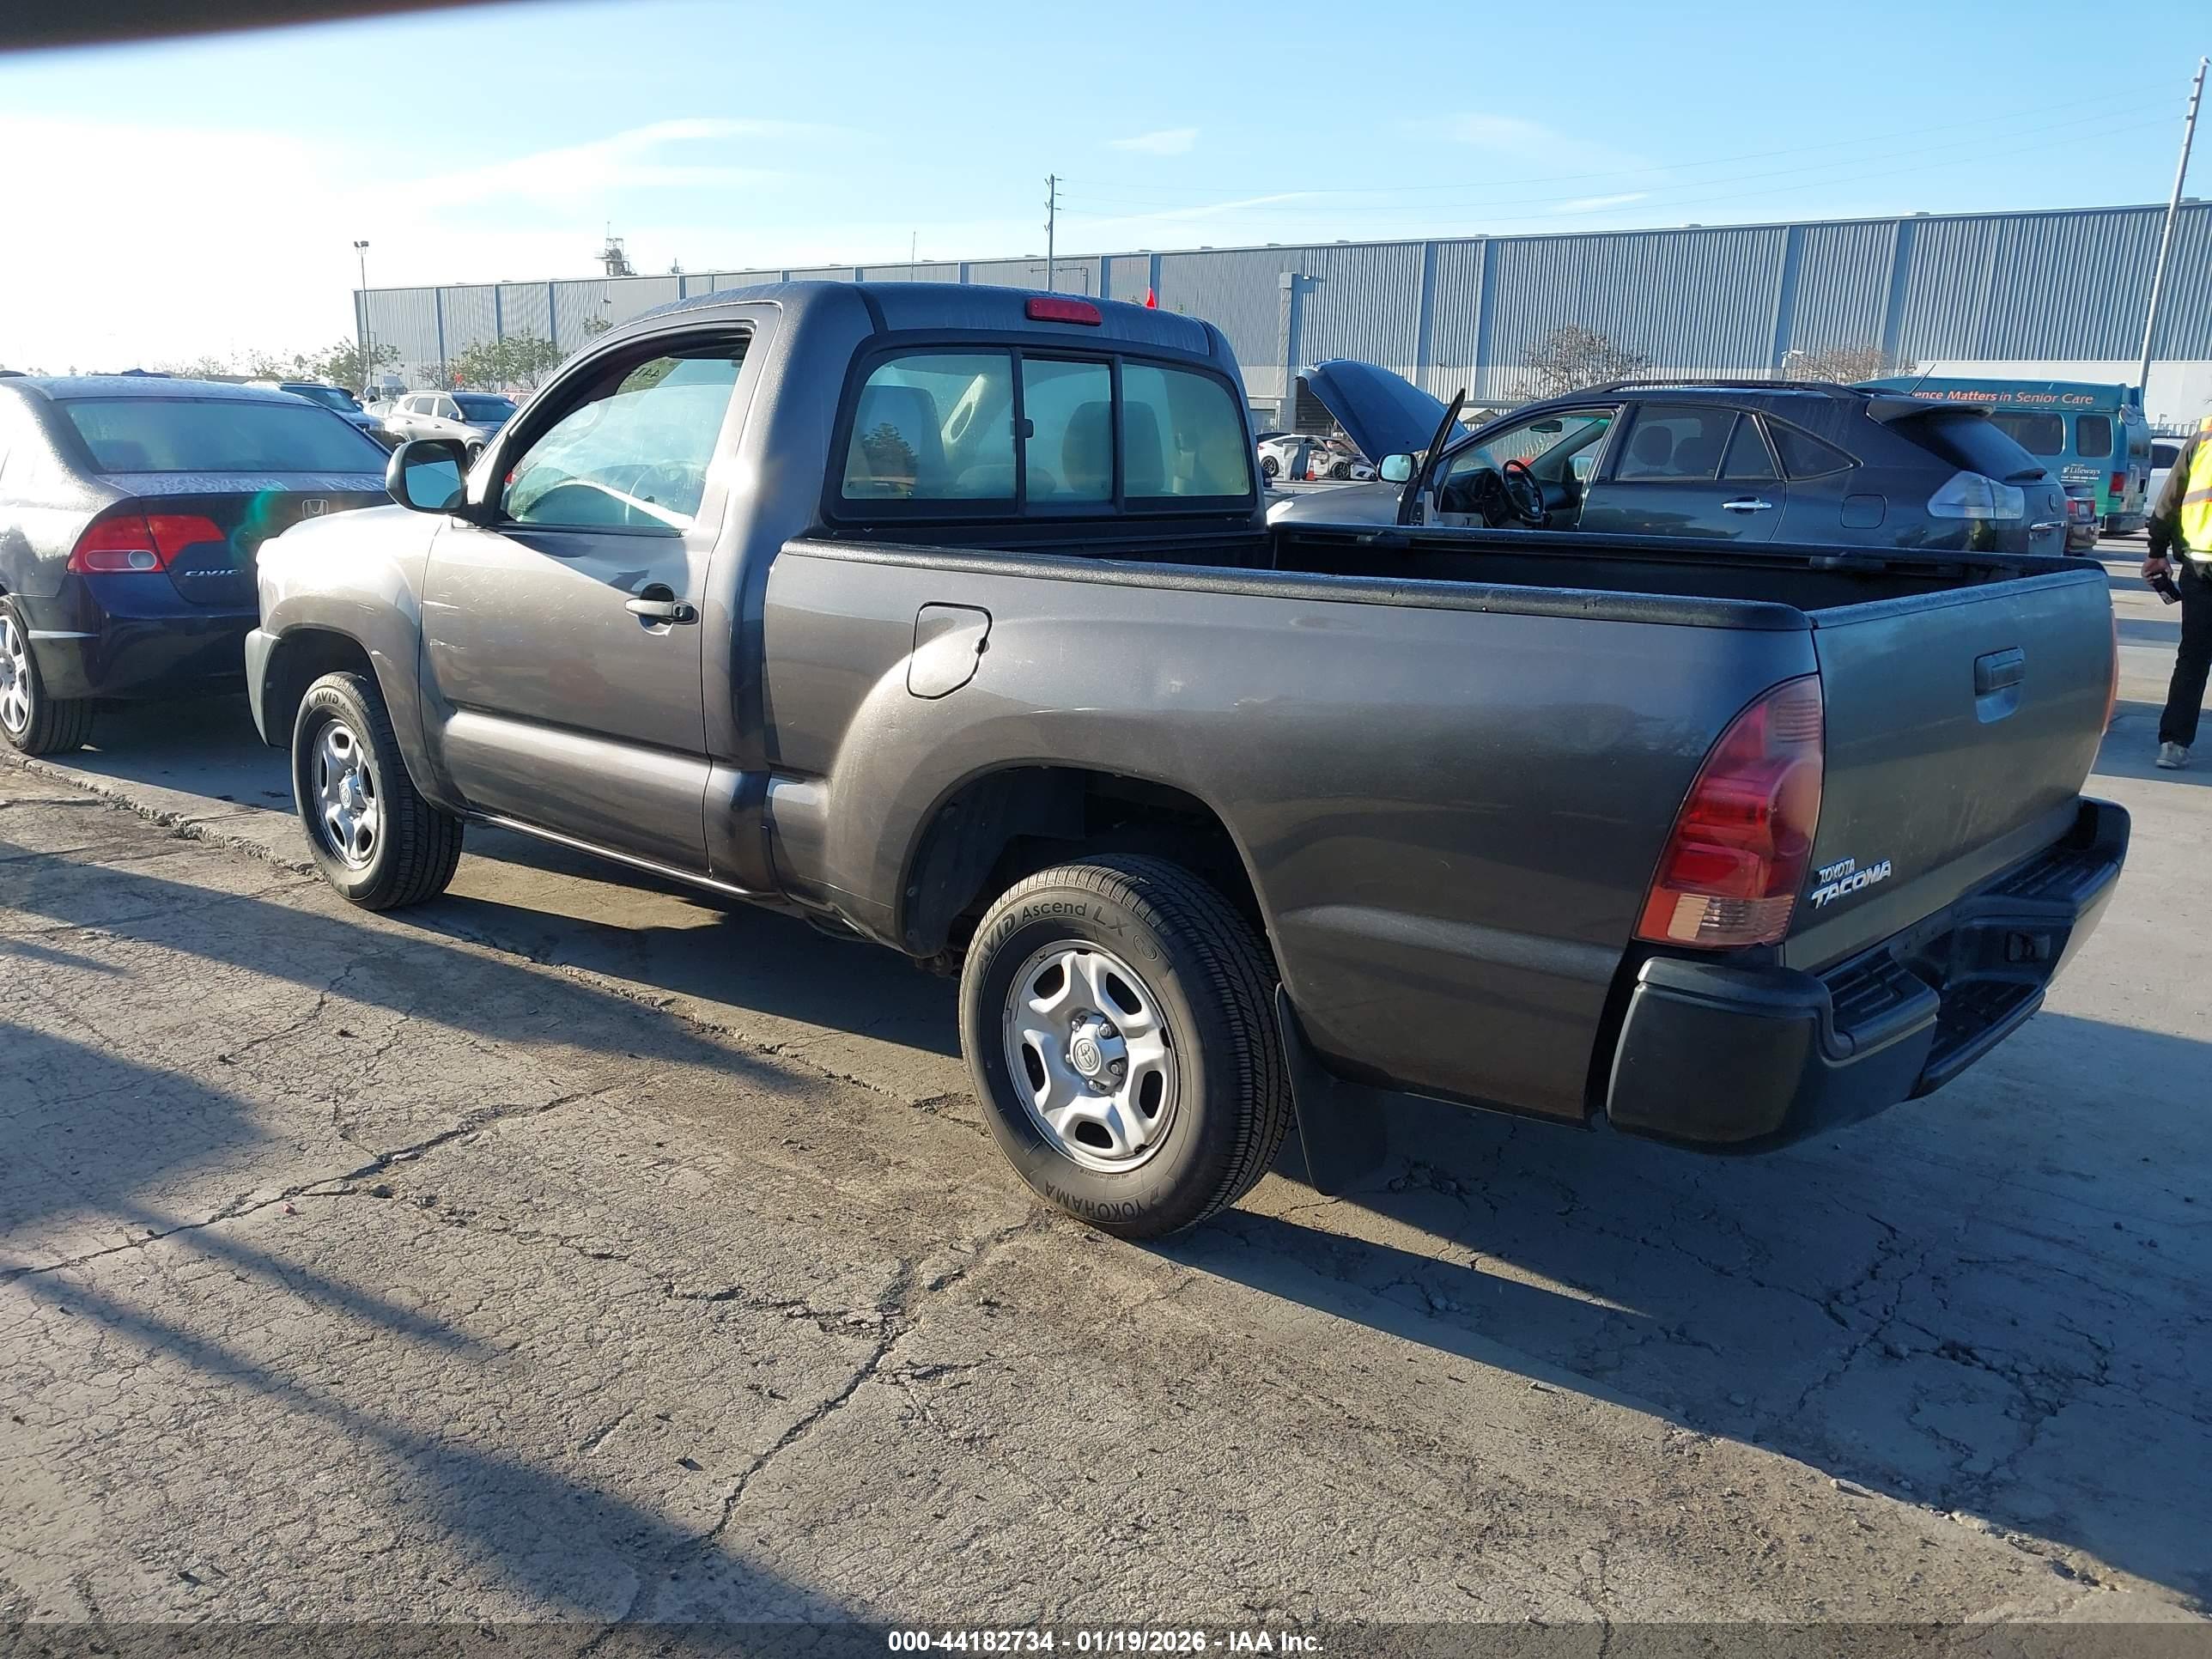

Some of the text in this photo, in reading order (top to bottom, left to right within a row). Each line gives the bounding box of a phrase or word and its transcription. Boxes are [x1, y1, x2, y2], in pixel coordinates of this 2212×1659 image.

[1947, 391, 1996, 401] Matters
[1999, 392, 2011, 402] in
[2015, 392, 2058, 403] Senior
[2062, 393, 2094, 404] Care
[313, 691, 339, 705] AVID
[1811, 860, 1892, 909] TACOMA
[1819, 859, 1855, 885] TOYOTA
[977, 913, 1016, 977] AVID
[1022, 902, 1087, 923] Ascend
[1045, 1181, 1146, 1223] YOKOHAMA
